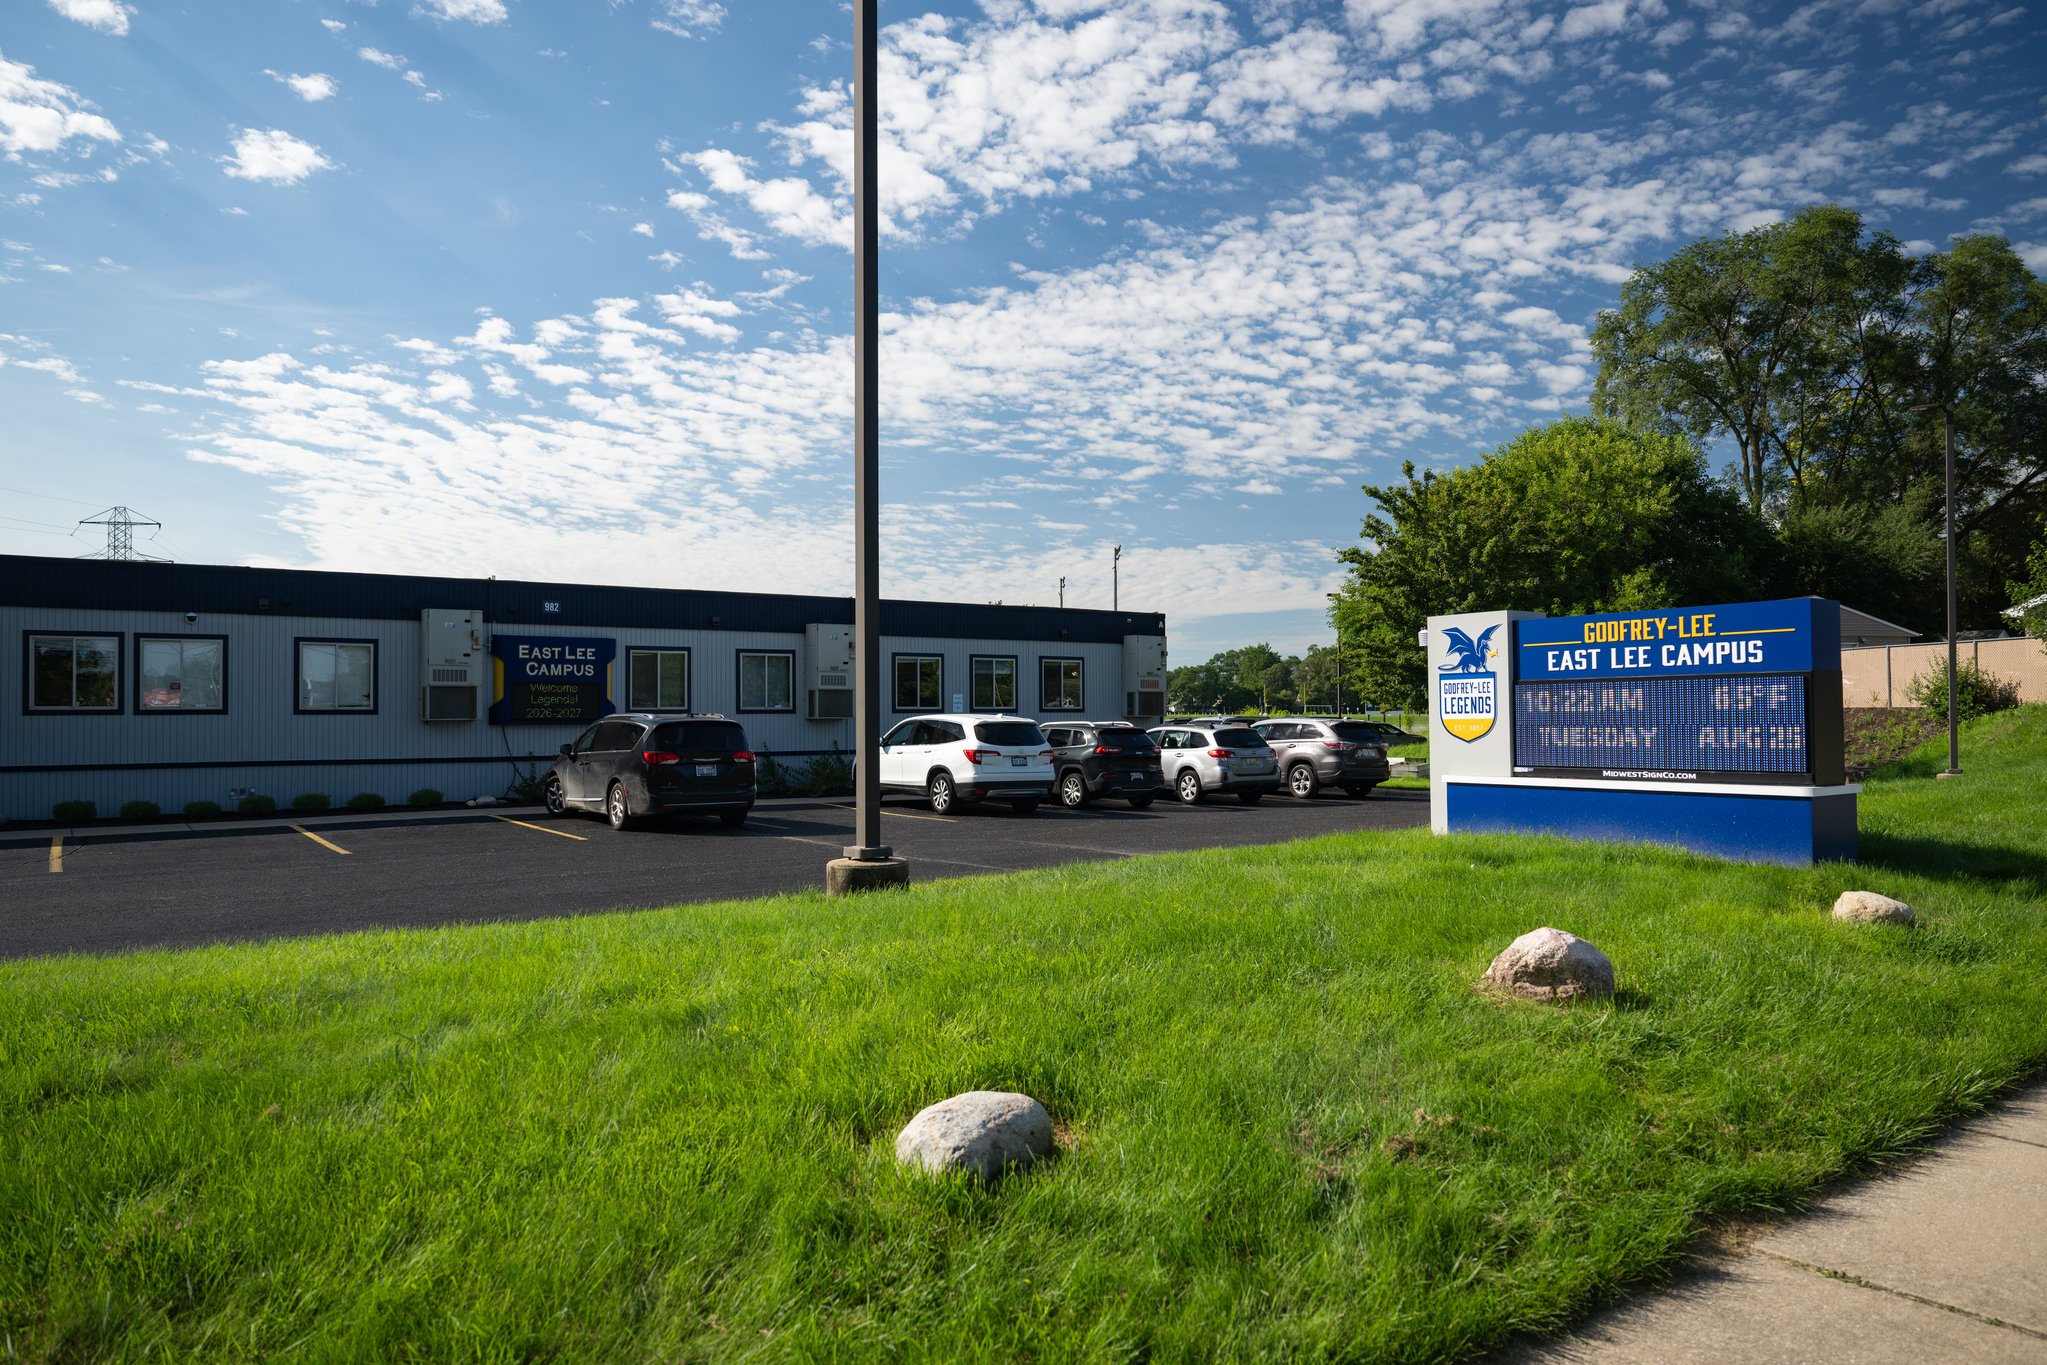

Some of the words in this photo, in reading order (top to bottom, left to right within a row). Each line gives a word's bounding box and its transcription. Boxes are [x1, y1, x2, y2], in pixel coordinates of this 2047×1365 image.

[544, 602, 559, 612] 982
[1583, 613, 1717, 644] GODFREY-LEE
[518, 644, 562, 660] EAST
[565, 645, 596, 660] LEE
[1547, 648, 1601, 671] EAST
[1611, 646, 1652, 669] LEE
[1661, 640, 1763, 667] CAMPUS
[525, 661, 594, 676] CAMPUS
[529, 683, 578, 693] Welcome
[1443, 681, 1491, 695] GODFREY-LEE
[530, 694, 578, 706] Legends!
[1444, 696, 1491, 714] LEGENDS
[1599, 688, 1643, 711] AM
[526, 708, 582, 718] 2026-2027
[1454, 724, 1467, 732] EST.
[1539, 727, 1658, 747] TUESDAY
[1699, 726, 1761, 748] AUG
[1770, 726, 1801, 748] 25
